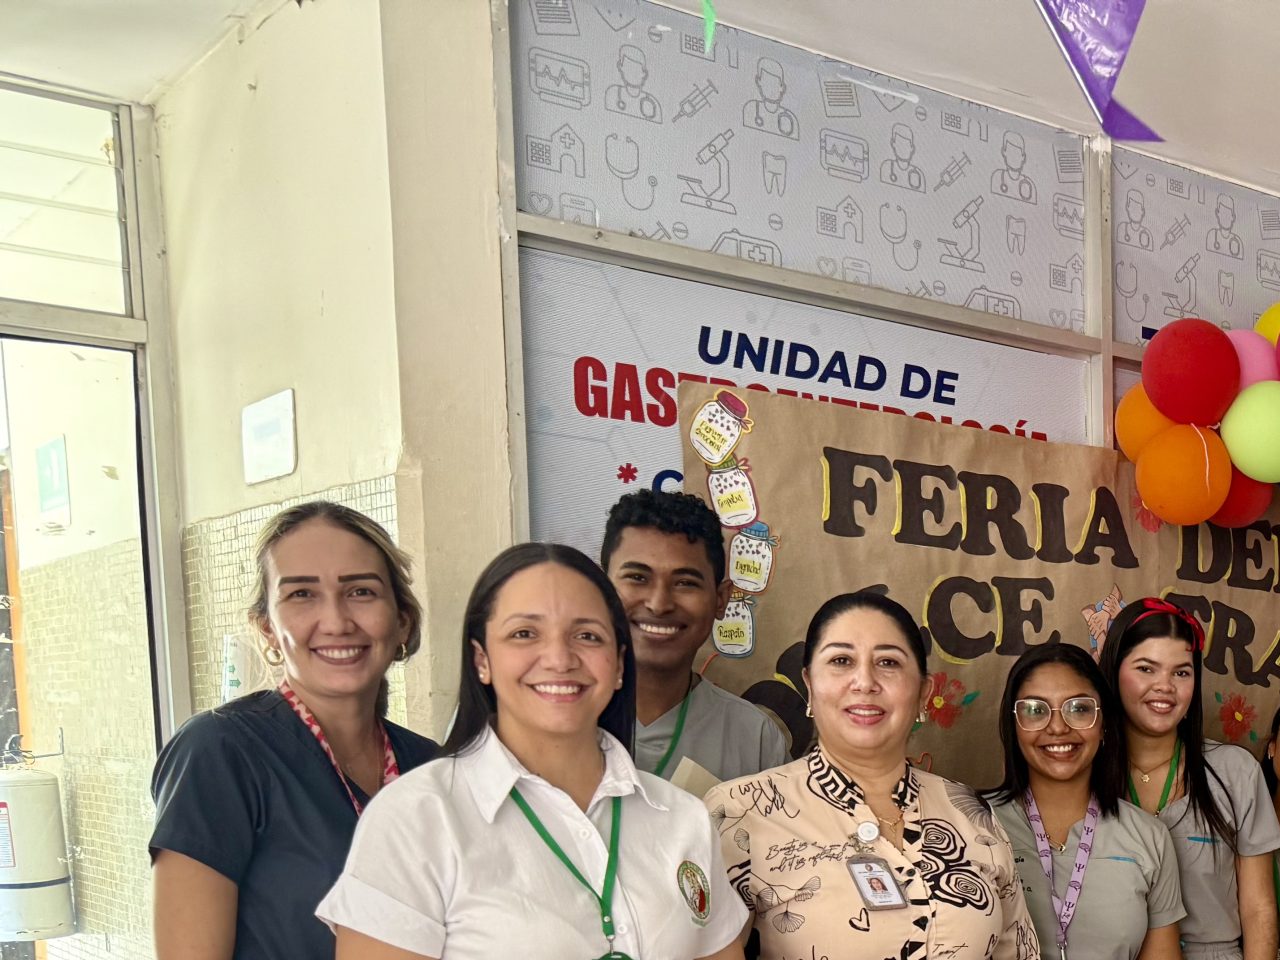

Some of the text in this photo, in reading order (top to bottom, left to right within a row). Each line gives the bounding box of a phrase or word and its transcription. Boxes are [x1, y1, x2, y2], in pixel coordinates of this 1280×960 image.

[698, 326, 887, 391] UNIDAD
[901, 364, 959, 405] DE
[820, 446, 1140, 568] FERIA
